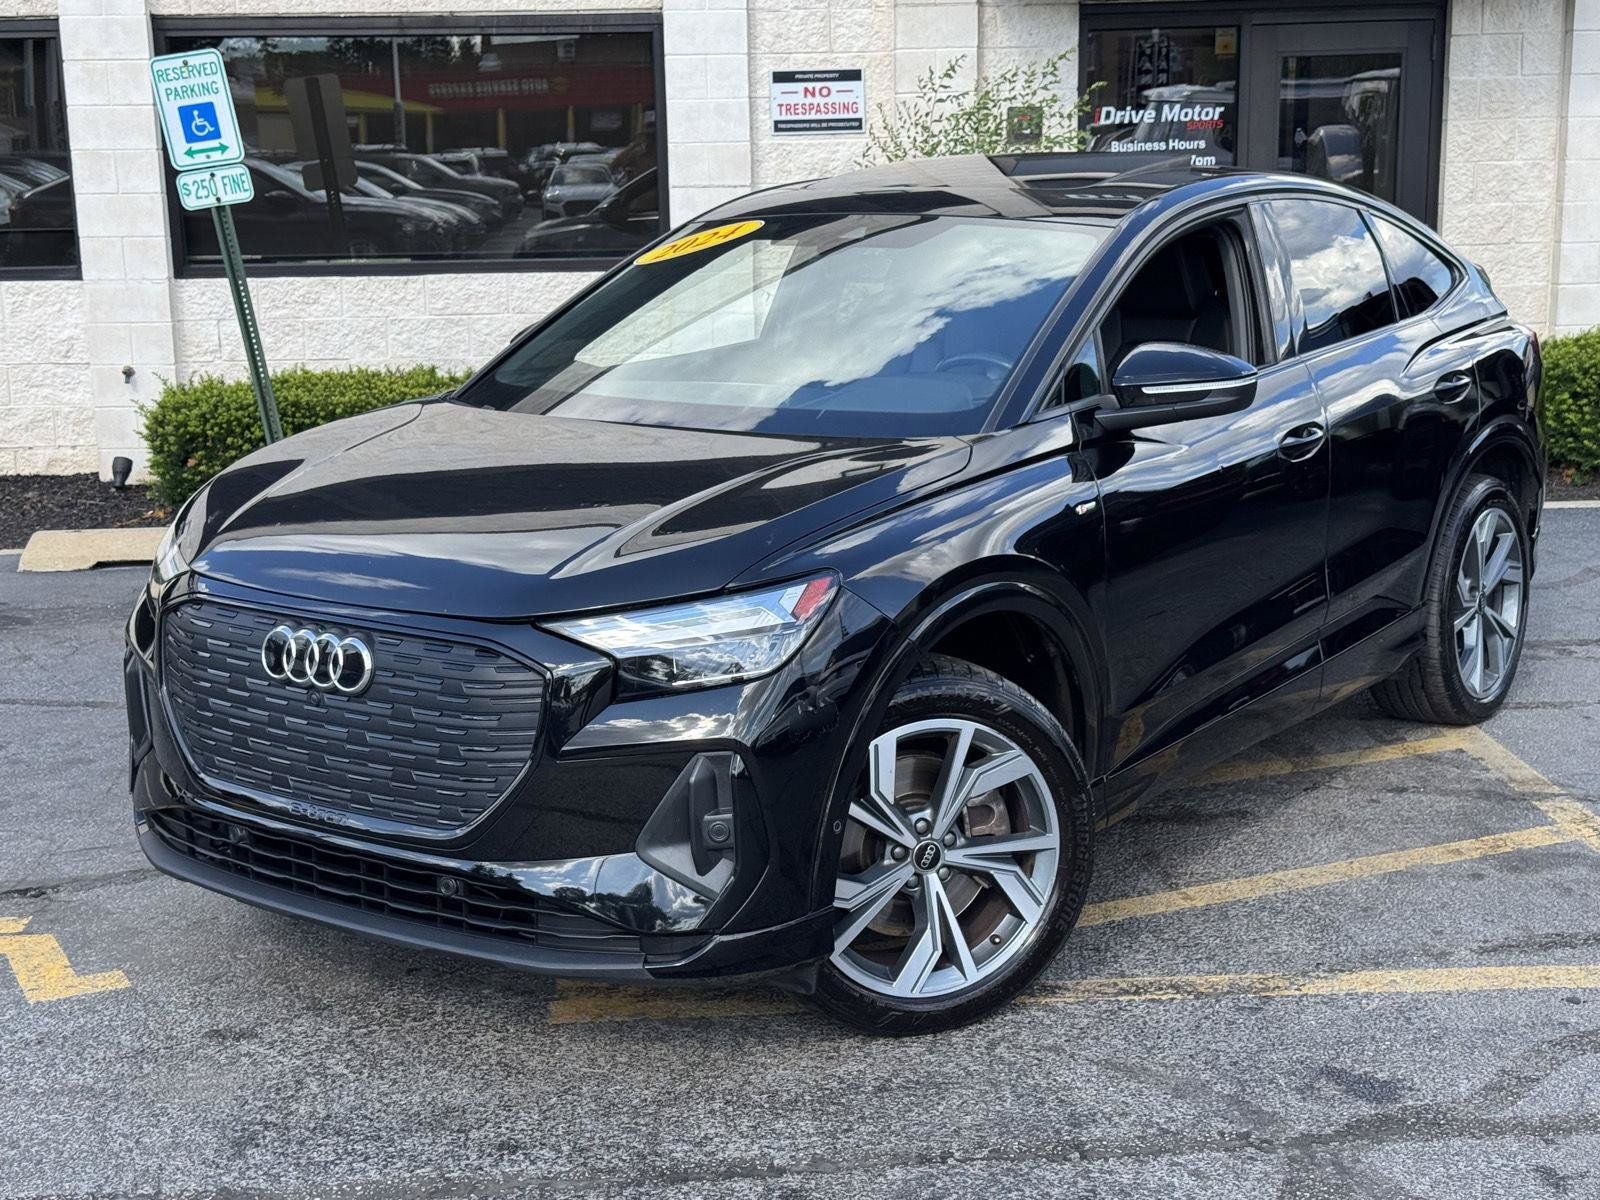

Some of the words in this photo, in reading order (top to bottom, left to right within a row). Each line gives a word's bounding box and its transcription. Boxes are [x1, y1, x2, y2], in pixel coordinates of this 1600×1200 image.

[156, 61, 219, 84] RESERVED
[165, 81, 220, 102] PARKING
[804, 86, 832, 98] NO
[777, 101, 859, 116] TRESPASSING
[1093, 104, 1156, 126] iDrive
[1160, 103, 1225, 123] Motor
[1186, 119, 1224, 130] SPORTS
[1110, 140, 1167, 153] Business
[1168, 138, 1206, 151] Hours
[222, 172, 250, 196] FINE
[653, 222, 747, 261] 2024
